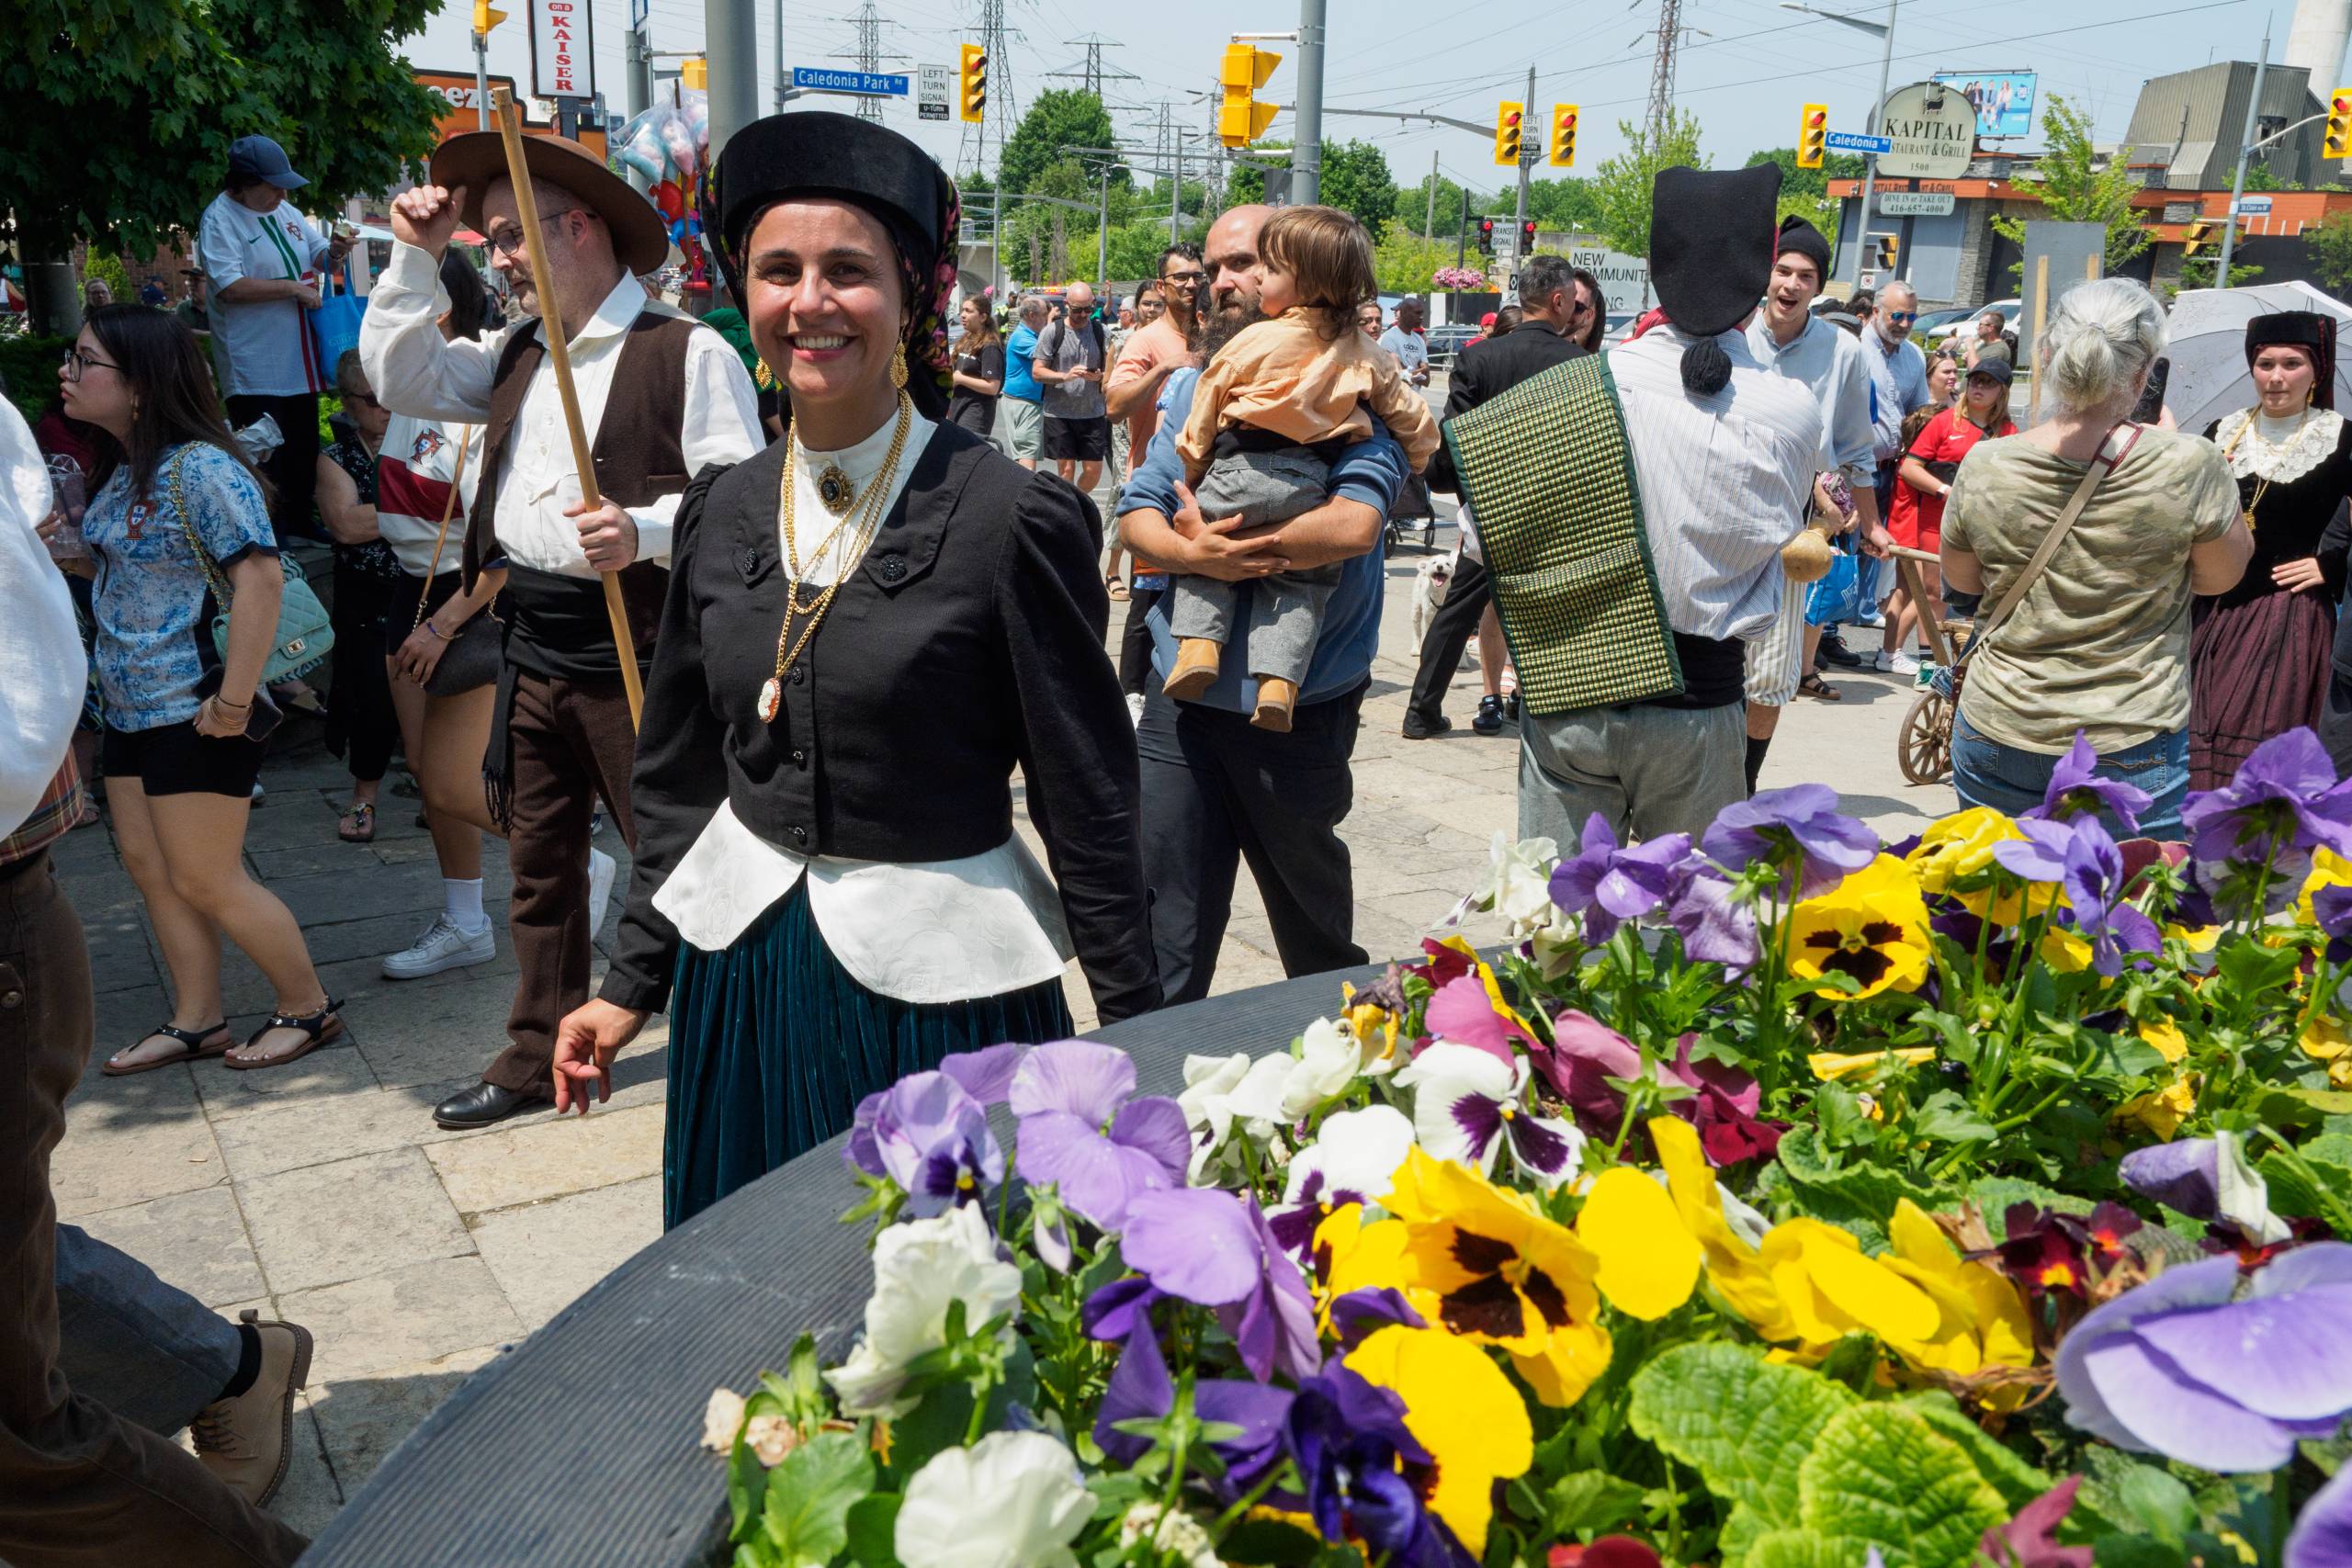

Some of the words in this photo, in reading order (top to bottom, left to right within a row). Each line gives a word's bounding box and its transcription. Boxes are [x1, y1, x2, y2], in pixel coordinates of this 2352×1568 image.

[551, 16, 574, 91] KAISER
[923, 69, 944, 78] LEFT
[798, 70, 858, 87] Caledonia
[864, 75, 890, 90] Park
[895, 77, 903, 85] Rd
[922, 81, 945, 90] TURN
[920, 93, 947, 102] SIGNAL
[1523, 125, 1538, 134] TURN
[1885, 118, 1966, 141] KAPITAL
[1828, 133, 1878, 149] Caledonia
[1931, 142, 1939, 156] &
[1941, 143, 1966, 158] GRILL
[1911, 163, 1929, 171] 1500
[1884, 194, 1901, 202] DINE
[1919, 195, 1935, 203] TAKE
[1938, 195, 1951, 203] OUT
[1890, 204, 1945, 213] 416-657-4000
[1493, 227, 1514, 235] TRANSIT
[1573, 253, 1605, 265] NEW
